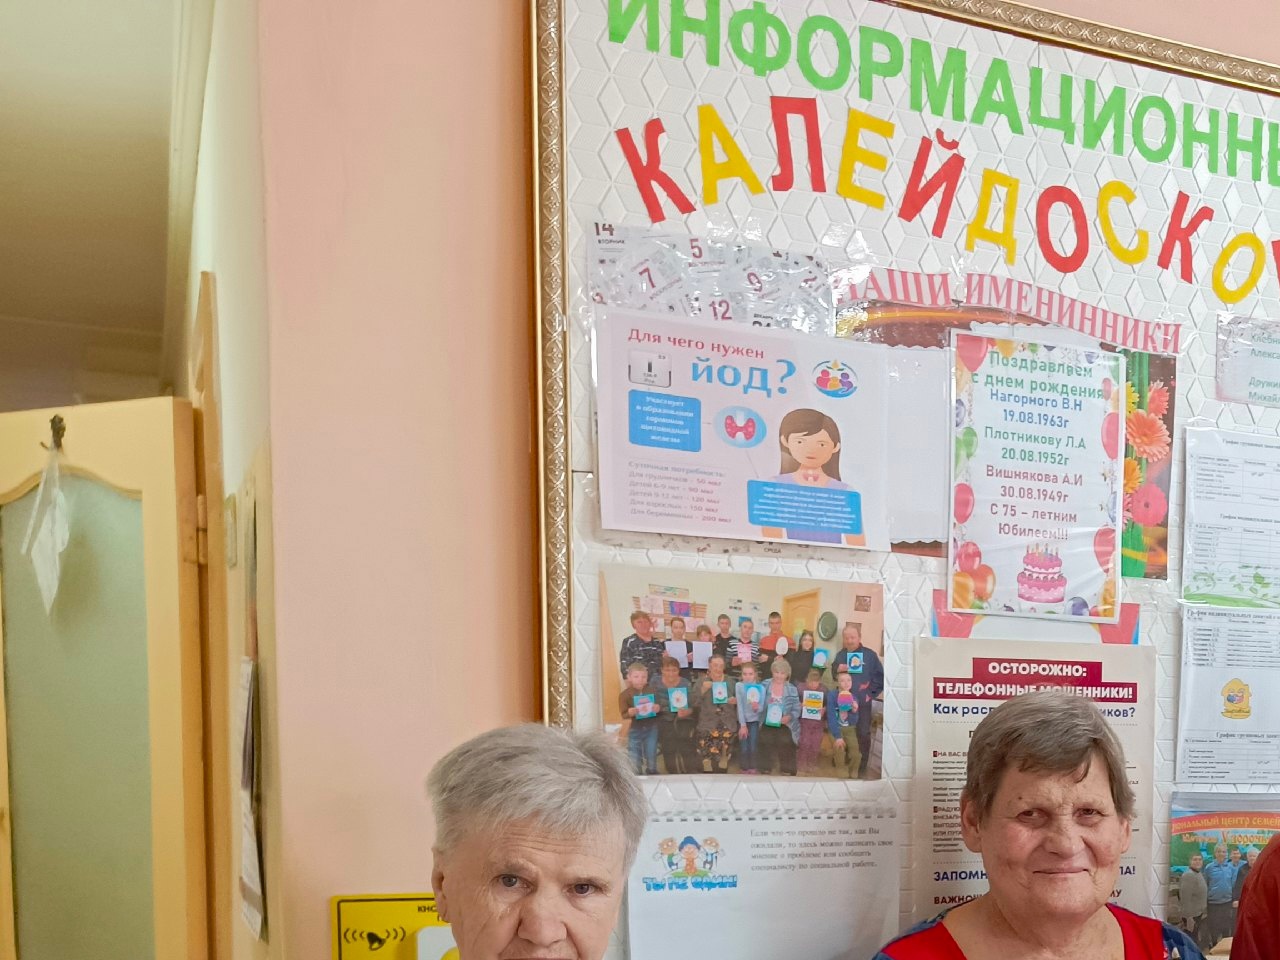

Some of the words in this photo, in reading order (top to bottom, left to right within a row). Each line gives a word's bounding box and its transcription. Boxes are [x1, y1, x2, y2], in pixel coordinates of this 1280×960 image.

[689, 238, 703, 259] 5
[639, 267, 656, 289] 7
[709, 300, 733, 320] 12
[964, 272, 1183, 354] ИМЕНИННИКИ
[628, 328, 661, 344] Для
[667, 337, 705, 350] чего
[711, 342, 764, 359] нужен
[989, 350, 1093, 378] Поздравляем
[691, 356, 797, 398] йод?
[984, 374, 1024, 391] днем
[1030, 379, 1105, 401] рождения
[990, 389, 1058, 411] Нагорного
[1062, 397, 1083, 412] В.Н
[1003, 408, 1070, 429] 19.08.1963г
[984, 426, 1062, 449] Плотникову
[1001, 447, 1070, 467] 20.08.1952г
[986, 465, 1059, 485] Вишнякова
[1000, 485, 1069, 504] 30.08.1949г
[1002, 504, 1017, 517] 75
[1031, 509, 1078, 523] летним
[988, 662, 1087, 677] ОСТОРОЖНО:
[936, 682, 1036, 697] ТЕЛЕФОННЫЕ
[933, 703, 959, 715] Как
[933, 870, 989, 882] ЗАПОМН
